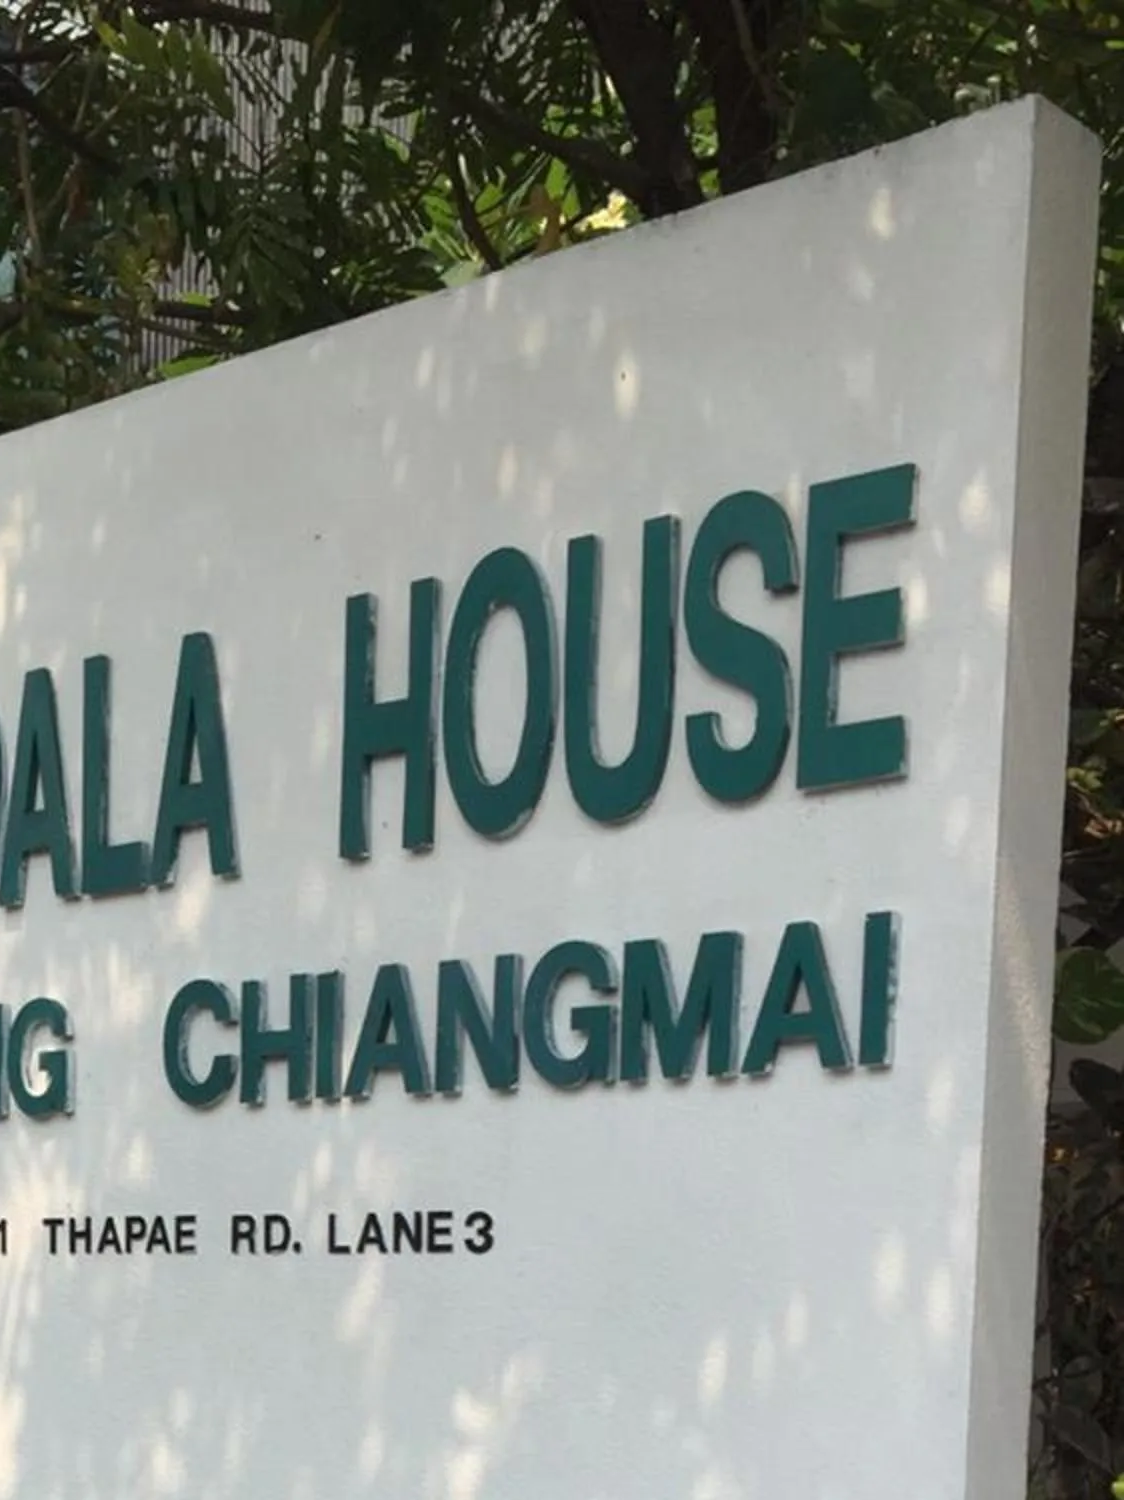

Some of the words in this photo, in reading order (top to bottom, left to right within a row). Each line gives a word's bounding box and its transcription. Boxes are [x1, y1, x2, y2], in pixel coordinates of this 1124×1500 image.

[339, 463, 918, 863] HOUSE
[162, 910, 901, 1110] CHIANGMAI
[43, 1214, 198, 1255] THAPAE
[230, 1214, 303, 1255] RD.
